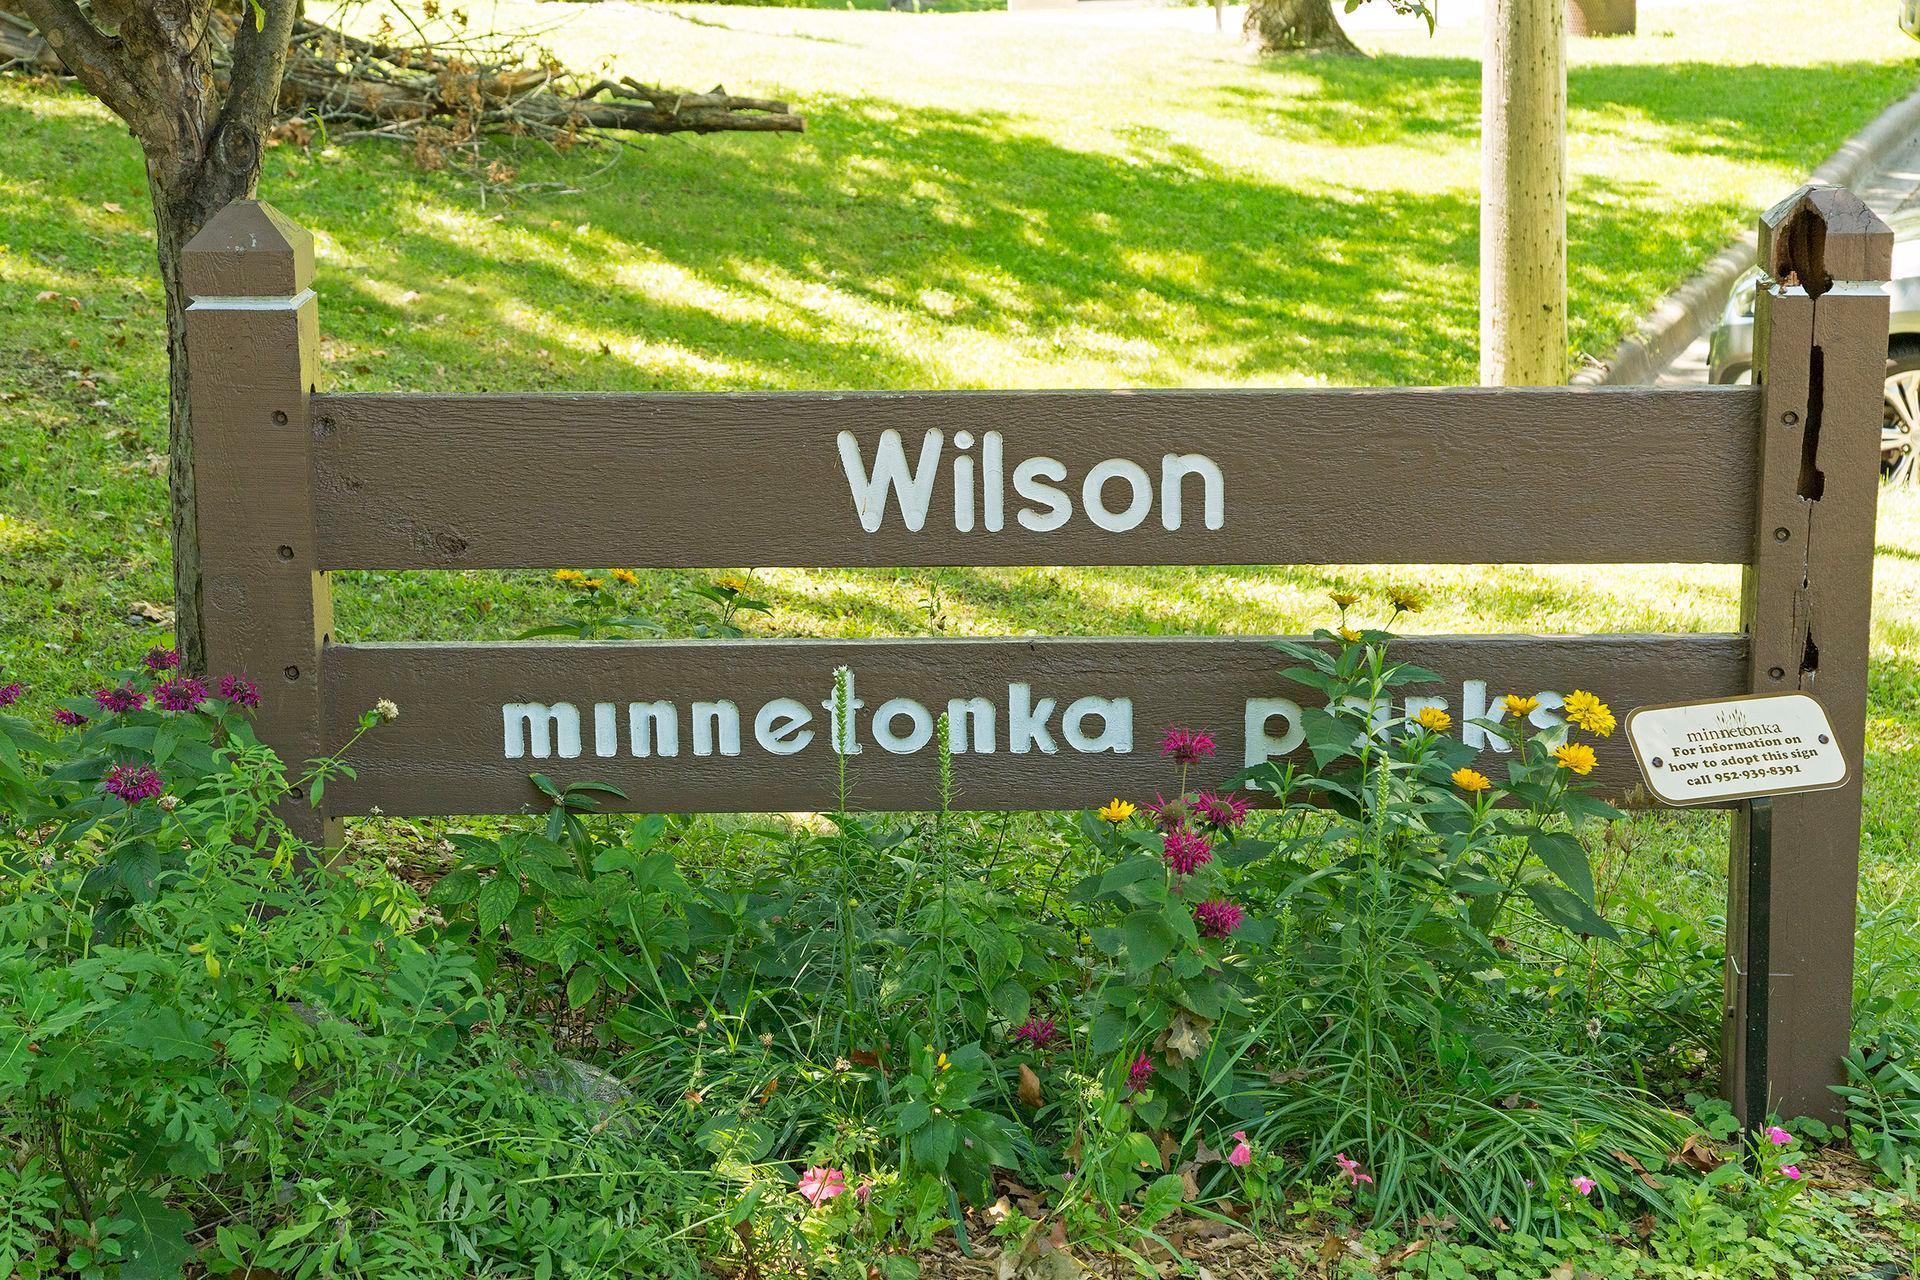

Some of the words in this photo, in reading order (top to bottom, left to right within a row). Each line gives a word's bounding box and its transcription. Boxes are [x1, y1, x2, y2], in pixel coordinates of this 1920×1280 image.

[837, 427, 1225, 533] Wilson
[502, 666, 1135, 759] minnetonka
[1687, 722, 1782, 743] minnetonka
[1672, 746, 1697, 757] For
[1699, 736, 1782, 755] information
[1785, 735, 1802, 745] on
[1668, 762, 1699, 773] how
[1703, 758, 1717, 769] to
[1721, 753, 1761, 768] adopt
[1762, 749, 1788, 762] this
[1791, 748, 1818, 761] sign
[1687, 772, 1712, 786] call
